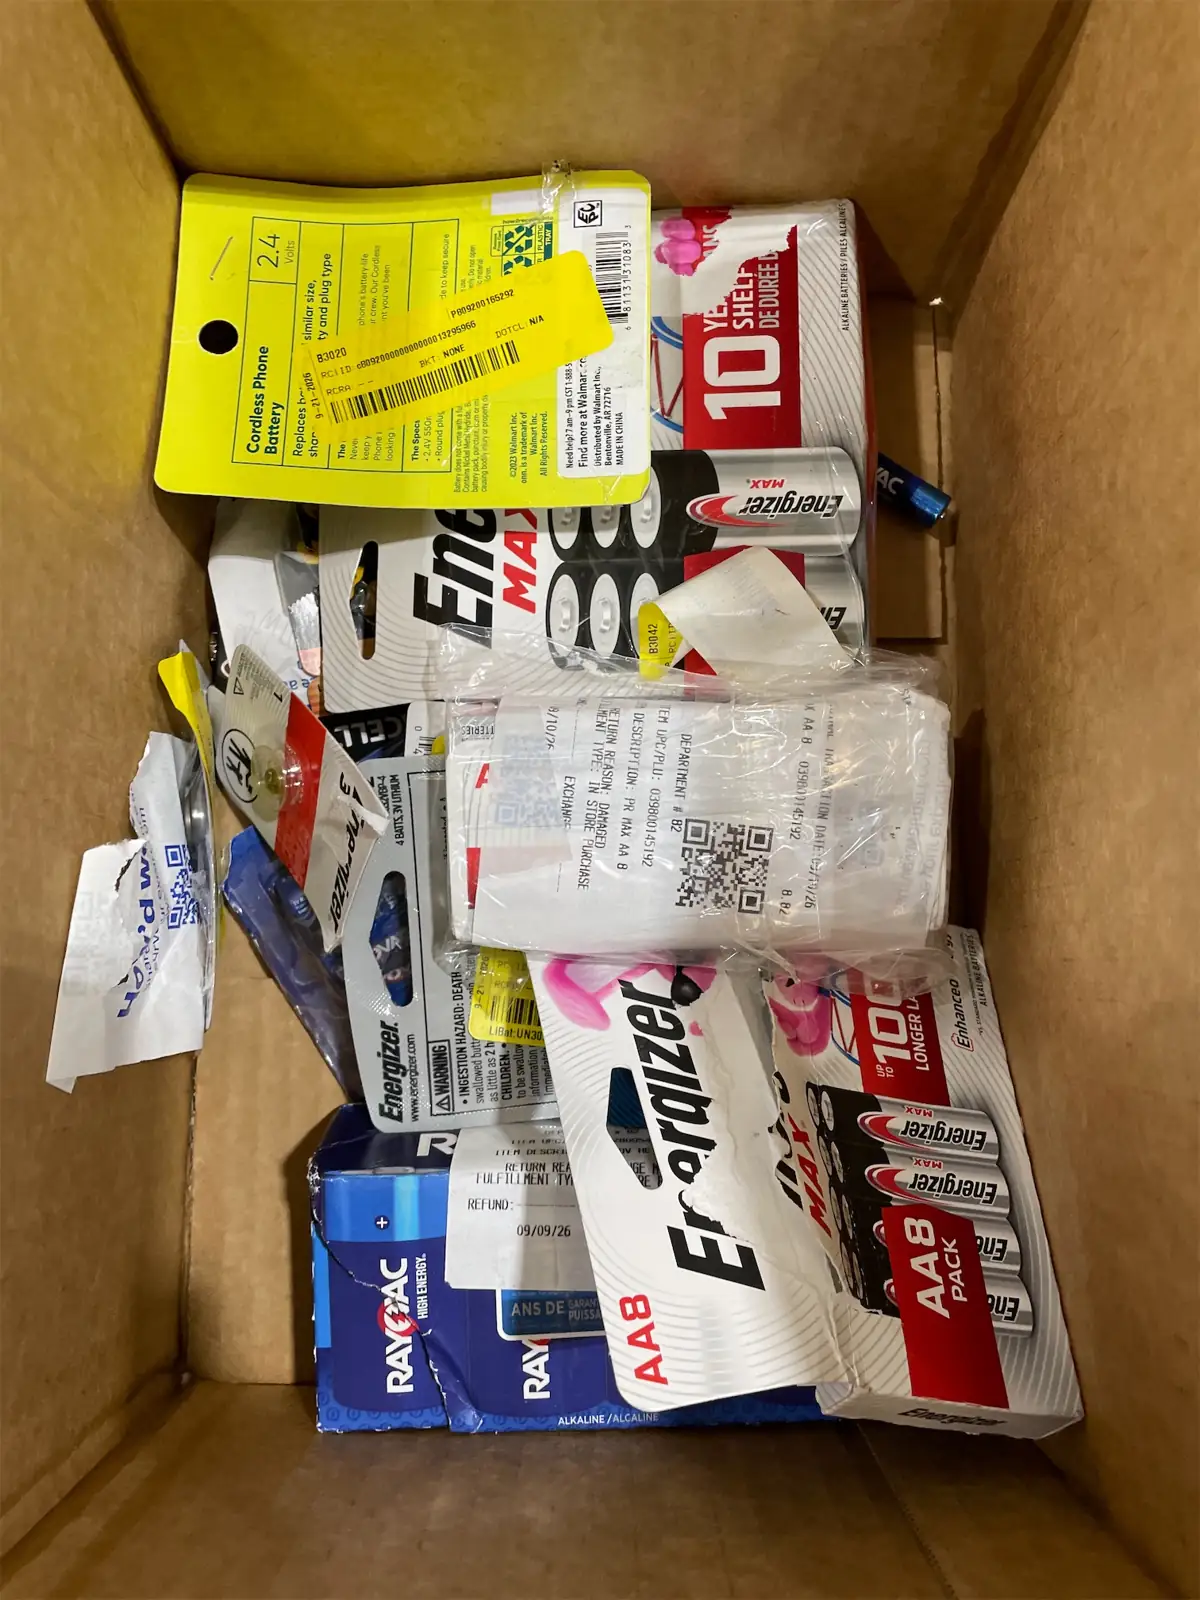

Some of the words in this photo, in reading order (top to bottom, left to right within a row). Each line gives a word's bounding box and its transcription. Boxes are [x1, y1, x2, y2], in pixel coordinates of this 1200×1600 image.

[838, 203, 847, 236] ALCALINES
[257, 233, 280, 269] 2.4
[285, 240, 296, 265] Volts
[839, 238, 848, 257] PILES
[322, 253, 333, 277] type
[372, 245, 381, 278] Cordless
[383, 264, 391, 283] been
[304, 280, 317, 303] size,
[317, 280, 332, 304] plug
[371, 280, 379, 294] Our
[754, 263, 780, 308] DURÉE
[840, 262, 849, 298] BATTERIES
[732, 267, 754, 330] SHELF
[302, 306, 315, 341] similar
[318, 306, 328, 328] and
[529, 315, 545, 326] N/A
[758, 309, 779, 328] DE
[840, 299, 850, 331] ALKALINE
[317, 346, 347, 364] B3020
[442, 343, 466, 360] NONE
[253, 345, 269, 390] Phone
[702, 334, 781, 420] 10
[564, 386, 572, 397] CST
[567, 398, 575, 408] pm
[593, 383, 601, 415] Walmart
[603, 387, 611, 409] 72716
[246, 393, 265, 455] Cordless
[510, 412, 518, 425] Inc.
[578, 410, 587, 419] at
[593, 415, 603, 424] by
[603, 409, 611, 420] AR
[615, 412, 624, 434] CHINA
[265, 402, 285, 455] Battery
[292, 407, 308, 457] Replaces
[540, 411, 548, 443] Reserved.
[579, 421, 588, 445] more
[337, 444, 346, 459] The
[374, 437, 383, 461] Phone
[385, 432, 395, 462] looking
[435, 425, 443, 456] Round
[565, 434, 575, 450] help?
[593, 425, 602, 467] Distributed
[603, 421, 613, 466] Bentonville,
[411, 446, 420, 461] The
[540, 445, 549, 466] Rights
[565, 451, 573, 468] Need
[578, 447, 588, 467] Find
[615, 444, 624, 465] MADE
[736, 490, 844, 519] Energizer
[648, 623, 658, 655] B3042
[605, 707, 620, 745] RETURN
[802, 717, 815, 731] AA
[589, 741, 605, 772] TYPE:
[624, 712, 645, 791] DESCRIPTION:
[650, 729, 668, 781] UPC/PLU:
[600, 749, 617, 796] REASON:
[674, 733, 693, 800] DEPARTMENT
[390, 774, 402, 803] LITHIUM
[587, 781, 600, 794] IN
[393, 804, 403, 814] 3V
[583, 799, 599, 833] STORE
[622, 797, 636, 812] PR
[672, 805, 684, 813] #
[594, 803, 610, 849] DAMAGED
[620, 817, 634, 837] MAX
[641, 788, 661, 868] 039800145192
[670, 818, 684, 833] 82
[618, 843, 631, 857] AA
[576, 838, 595, 891] PURCHASE
[778, 889, 793, 915] 8.82
[450, 971, 463, 1001] DEATH
[974, 972, 988, 1007] ALKALINE
[452, 1003, 467, 1045] HAZARD:
[907, 1013, 930, 1072] LONGER
[431, 1044, 450, 1097] WARNING
[455, 1046, 470, 1097] INGESTION
[486, 1057, 496, 1067] as
[876, 1063, 886, 1077] UP
[885, 1066, 894, 1079] TO
[406, 1033, 420, 1123] www.energizer.com
[470, 1052, 484, 1104] swallowed
[485, 1069, 497, 1092] little
[500, 1050, 513, 1101] CHILDREN.
[514, 1079, 525, 1089] be
[489, 1093, 498, 1102] as
[516, 1090, 526, 1099] to
[903, 1106, 934, 1118] MAX
[900, 1119, 987, 1152] Energizer
[505, 1162, 546, 1173] RETURN
[787, 1112, 833, 1239] MAX
[912, 1157, 944, 1170] MAX
[476, 1172, 550, 1186] FULFILLMENT
[908, 1171, 998, 1205] Energizer
[467, 1198, 514, 1211] REFUND:
[516, 1224, 571, 1238] 09/09/26
[904, 1216, 951, 1320] AA8
[941, 1237, 969, 1303] PACK
[416, 1294, 429, 1320] HIGH
[511, 1302, 541, 1317] ANS
[545, 1300, 565, 1315] DE
[618, 1293, 668, 1386] AA8
[558, 1415, 605, 1426] ALKALINE
